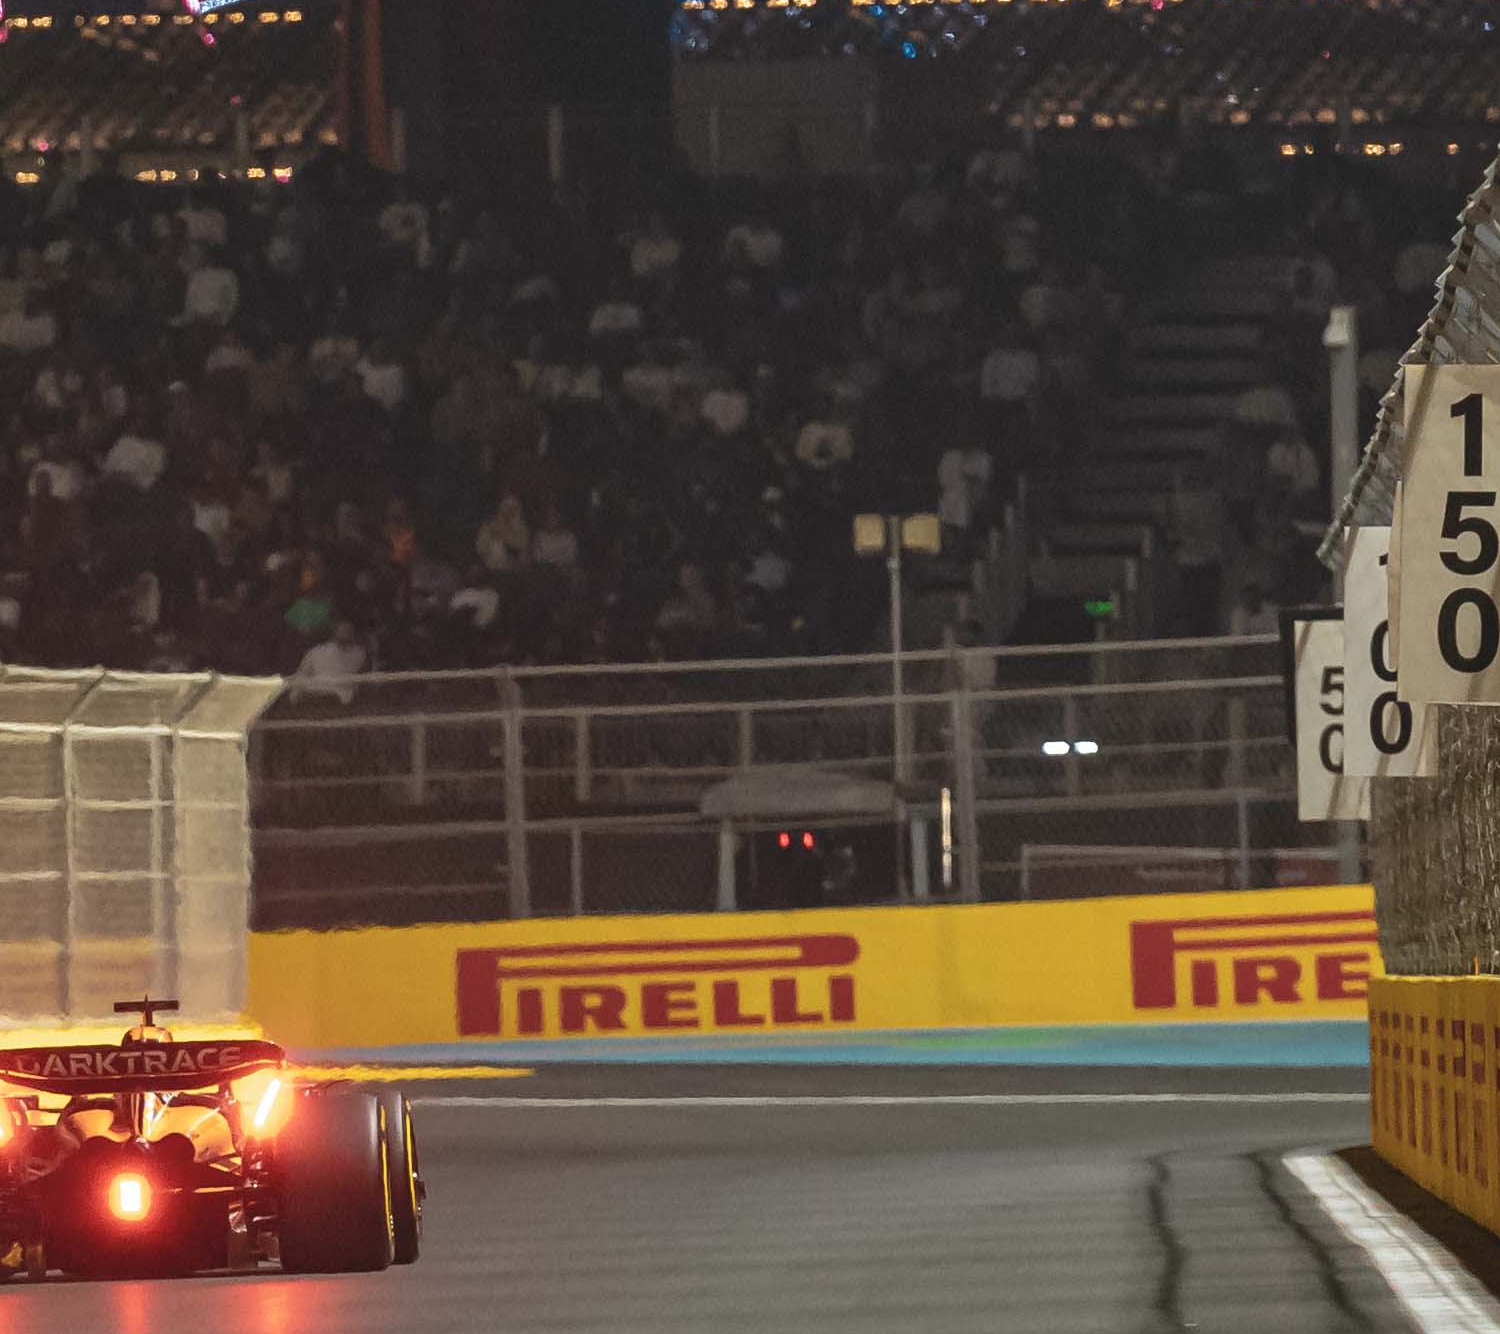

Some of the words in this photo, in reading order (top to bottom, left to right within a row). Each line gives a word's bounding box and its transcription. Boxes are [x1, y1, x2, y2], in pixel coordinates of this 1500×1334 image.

[1437, 392, 1500, 674] 150
[1369, 552, 1413, 755] 00
[456, 934, 860, 1037] PIRELLI
[1130, 909, 1378, 1009] PIRE
